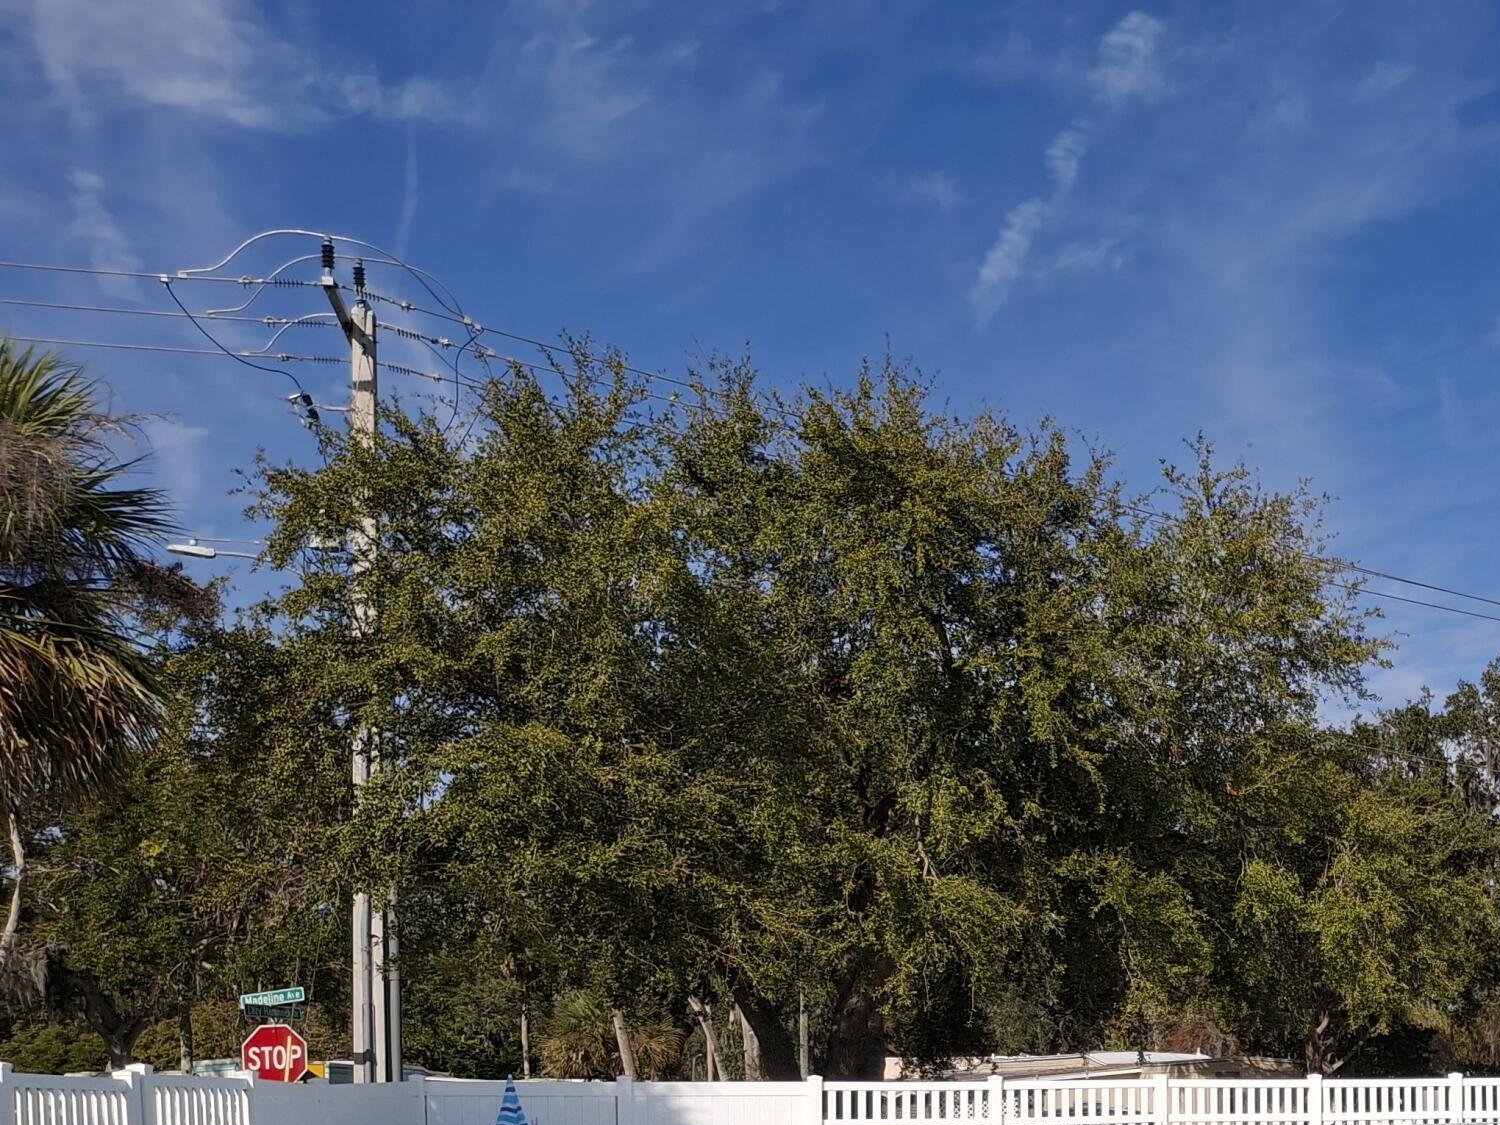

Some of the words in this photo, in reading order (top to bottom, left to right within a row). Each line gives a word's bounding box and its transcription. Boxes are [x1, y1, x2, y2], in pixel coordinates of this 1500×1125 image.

[245, 992, 285, 1006] Madeline
[287, 991, 300, 1000] Ave
[248, 1045, 301, 1070] STOP
